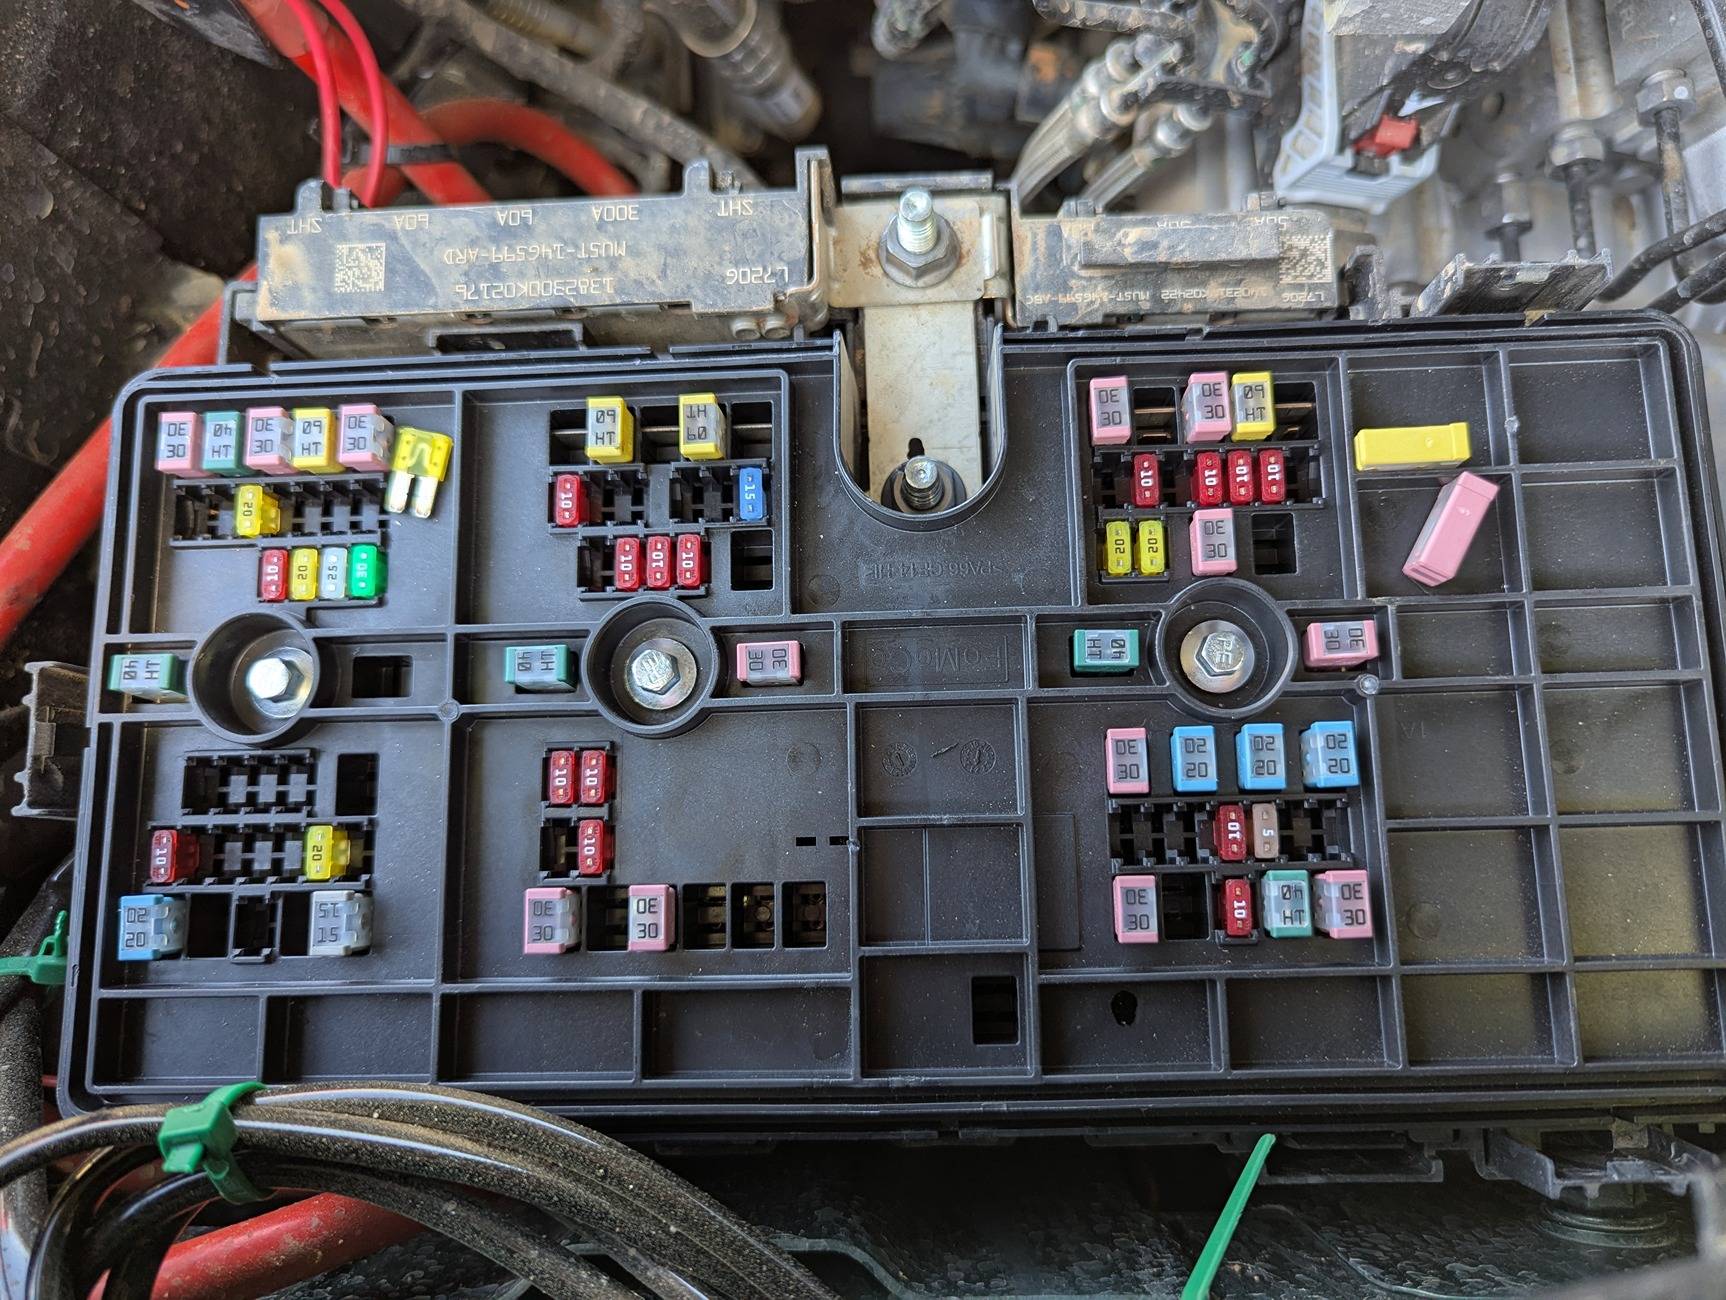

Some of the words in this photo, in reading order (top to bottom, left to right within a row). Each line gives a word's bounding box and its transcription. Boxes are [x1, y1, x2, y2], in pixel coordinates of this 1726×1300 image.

[498, 209, 532, 226] 60A
[593, 204, 640, 221] 300A
[395, 214, 429, 231] 60A
[1098, 389, 1120, 403] 30
[1201, 383, 1222, 397] 30
[1244, 385, 1264, 398] 60
[596, 410, 616, 423] 60
[686, 405, 707, 418] HT
[1101, 410, 1122, 425] 30
[1204, 405, 1225, 420] 30
[1244, 407, 1265, 421] HT
[167, 422, 187, 436] 30
[214, 424, 232, 437] 40
[255, 419, 274, 433] 30
[302, 420, 322, 434] 60
[348, 416, 367, 429] 30
[595, 432, 616, 445] HT
[687, 426, 707, 440] 60
[166, 444, 186, 458] 30
[212, 444, 232, 458] HT
[255, 439, 274, 454] 30
[302, 441, 322, 455] HT
[347, 436, 366, 451] 30
[1141, 471, 1153, 487] 10
[1205, 469, 1217, 486] 10
[1236, 466, 1248, 483] 10
[1268, 464, 1280, 481] 10
[561, 491, 572, 509] 10
[744, 484, 756, 500] 15
[242, 502, 253, 517] 20
[1204, 520, 1224, 535] 30
[1114, 538, 1126, 554] 20
[1148, 538, 1158, 554] 20
[1206, 542, 1228, 558] 30
[620, 555, 632, 571] 10
[652, 552, 664, 568] 10
[683, 552, 694, 568] 10
[266, 564, 280, 582] 10
[297, 564, 308, 580] 20
[327, 565, 338, 580] 25
[355, 563, 368, 579] 30
[1324, 629, 1339, 650] 30
[1348, 627, 1365, 648] 30
[1087, 638, 1102, 660] HT
[1110, 638, 1126, 660] 40
[518, 651, 532, 671] 40
[541, 651, 555, 670] HT
[749, 650, 764, 670] 30
[772, 648, 788, 668] 30
[124, 660, 137, 680] 40
[145, 660, 158, 680] HT
[1115, 738, 1138, 755] 30
[1184, 737, 1206, 754] 20
[1252, 736, 1275, 752] 20
[1326, 733, 1348, 750] 20
[1118, 764, 1140, 780] 30
[1185, 762, 1208, 778] 20
[1254, 760, 1276, 776] 20
[1327, 758, 1350, 774] 20
[556, 768, 568, 786] 10
[585, 768, 597, 786] 10
[1227, 822, 1240, 840] 10
[312, 844, 323, 862] 20
[584, 838, 596, 855] 10
[156, 848, 167, 866] 10
[1125, 888, 1148, 905] 30
[1280, 884, 1303, 900] 40
[1341, 883, 1364, 900] 30
[318, 902, 339, 918] 15
[534, 900, 553, 916] 30
[637, 898, 658, 914] 30
[1232, 900, 1246, 918] 10
[127, 908, 148, 923] 20
[1128, 914, 1150, 930] 30
[1282, 910, 1305, 925] HT
[1343, 908, 1366, 926] 30
[317, 927, 338, 944] 15
[533, 925, 553, 941] 30
[637, 922, 658, 939] 30
[125, 932, 146, 948] 20
